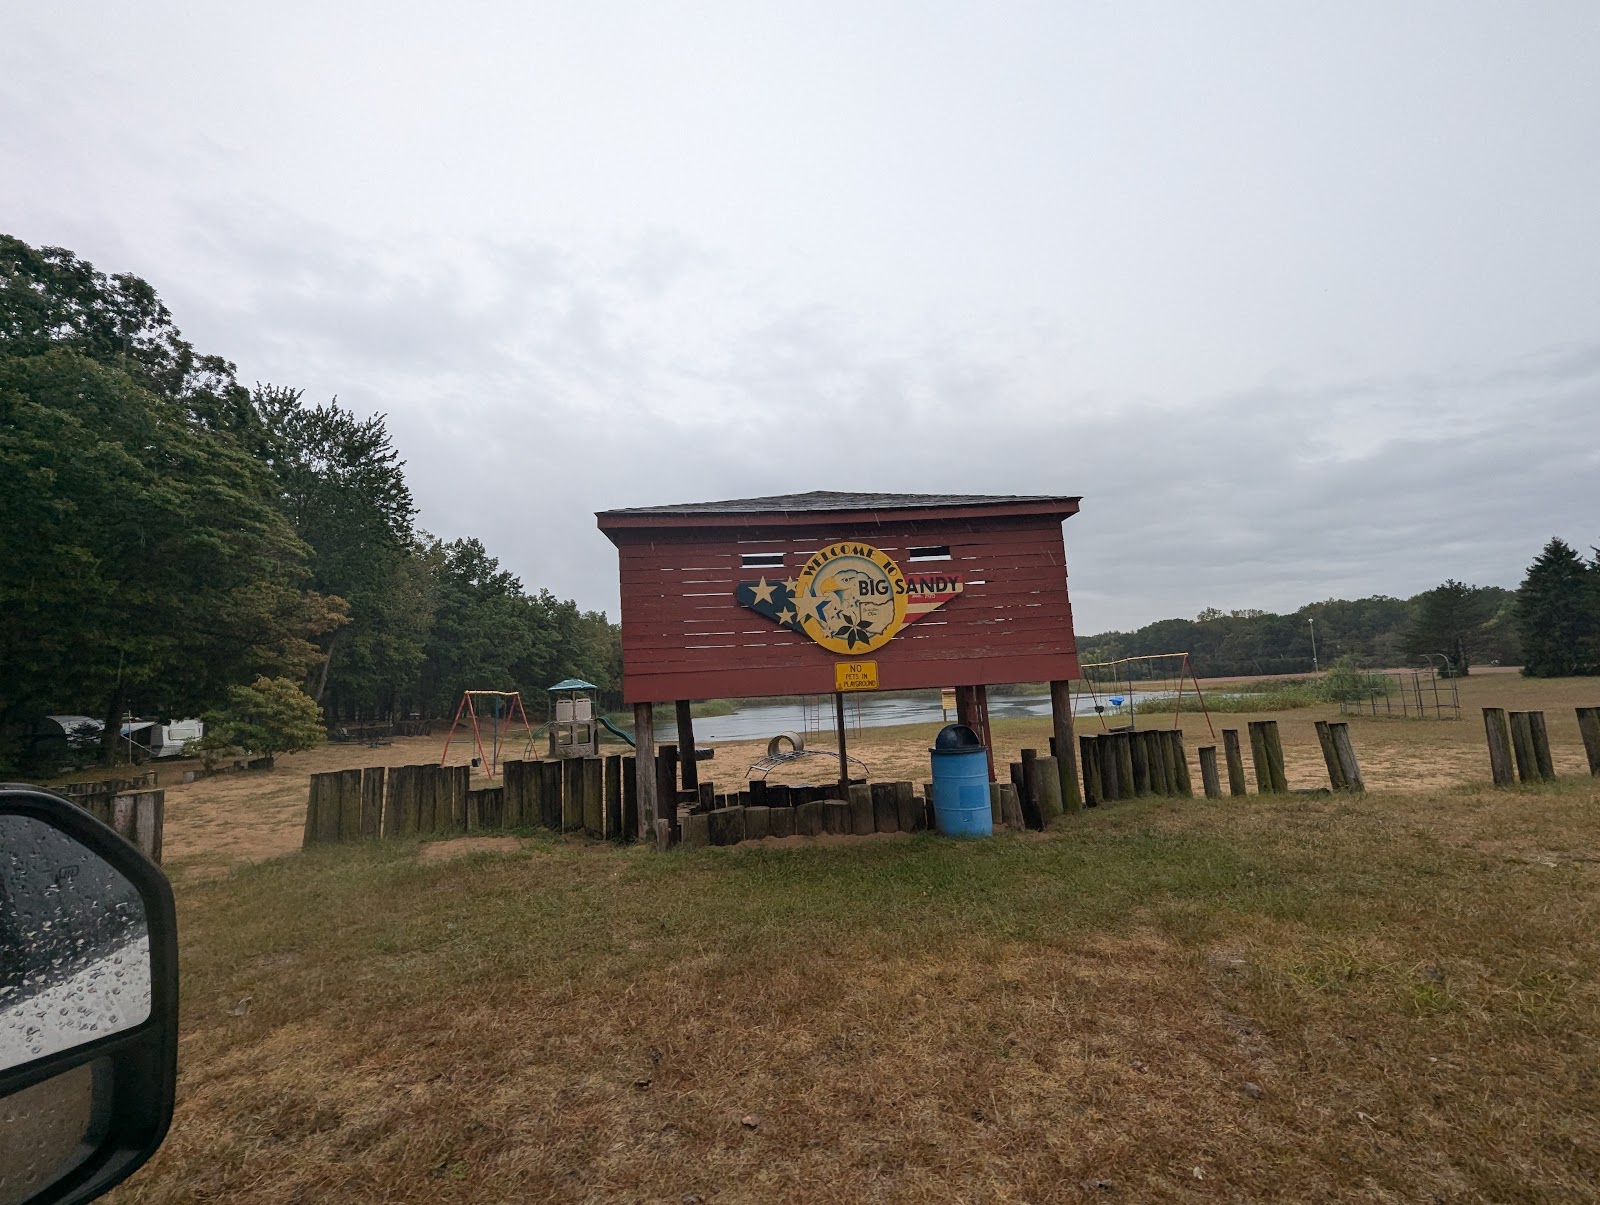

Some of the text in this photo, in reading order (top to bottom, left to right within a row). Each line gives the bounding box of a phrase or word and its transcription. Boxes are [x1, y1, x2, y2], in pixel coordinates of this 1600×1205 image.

[803, 544, 898, 577] WELCOME TO
[859, 576, 959, 596] BIG SANDY
[850, 664, 862, 672] NO
